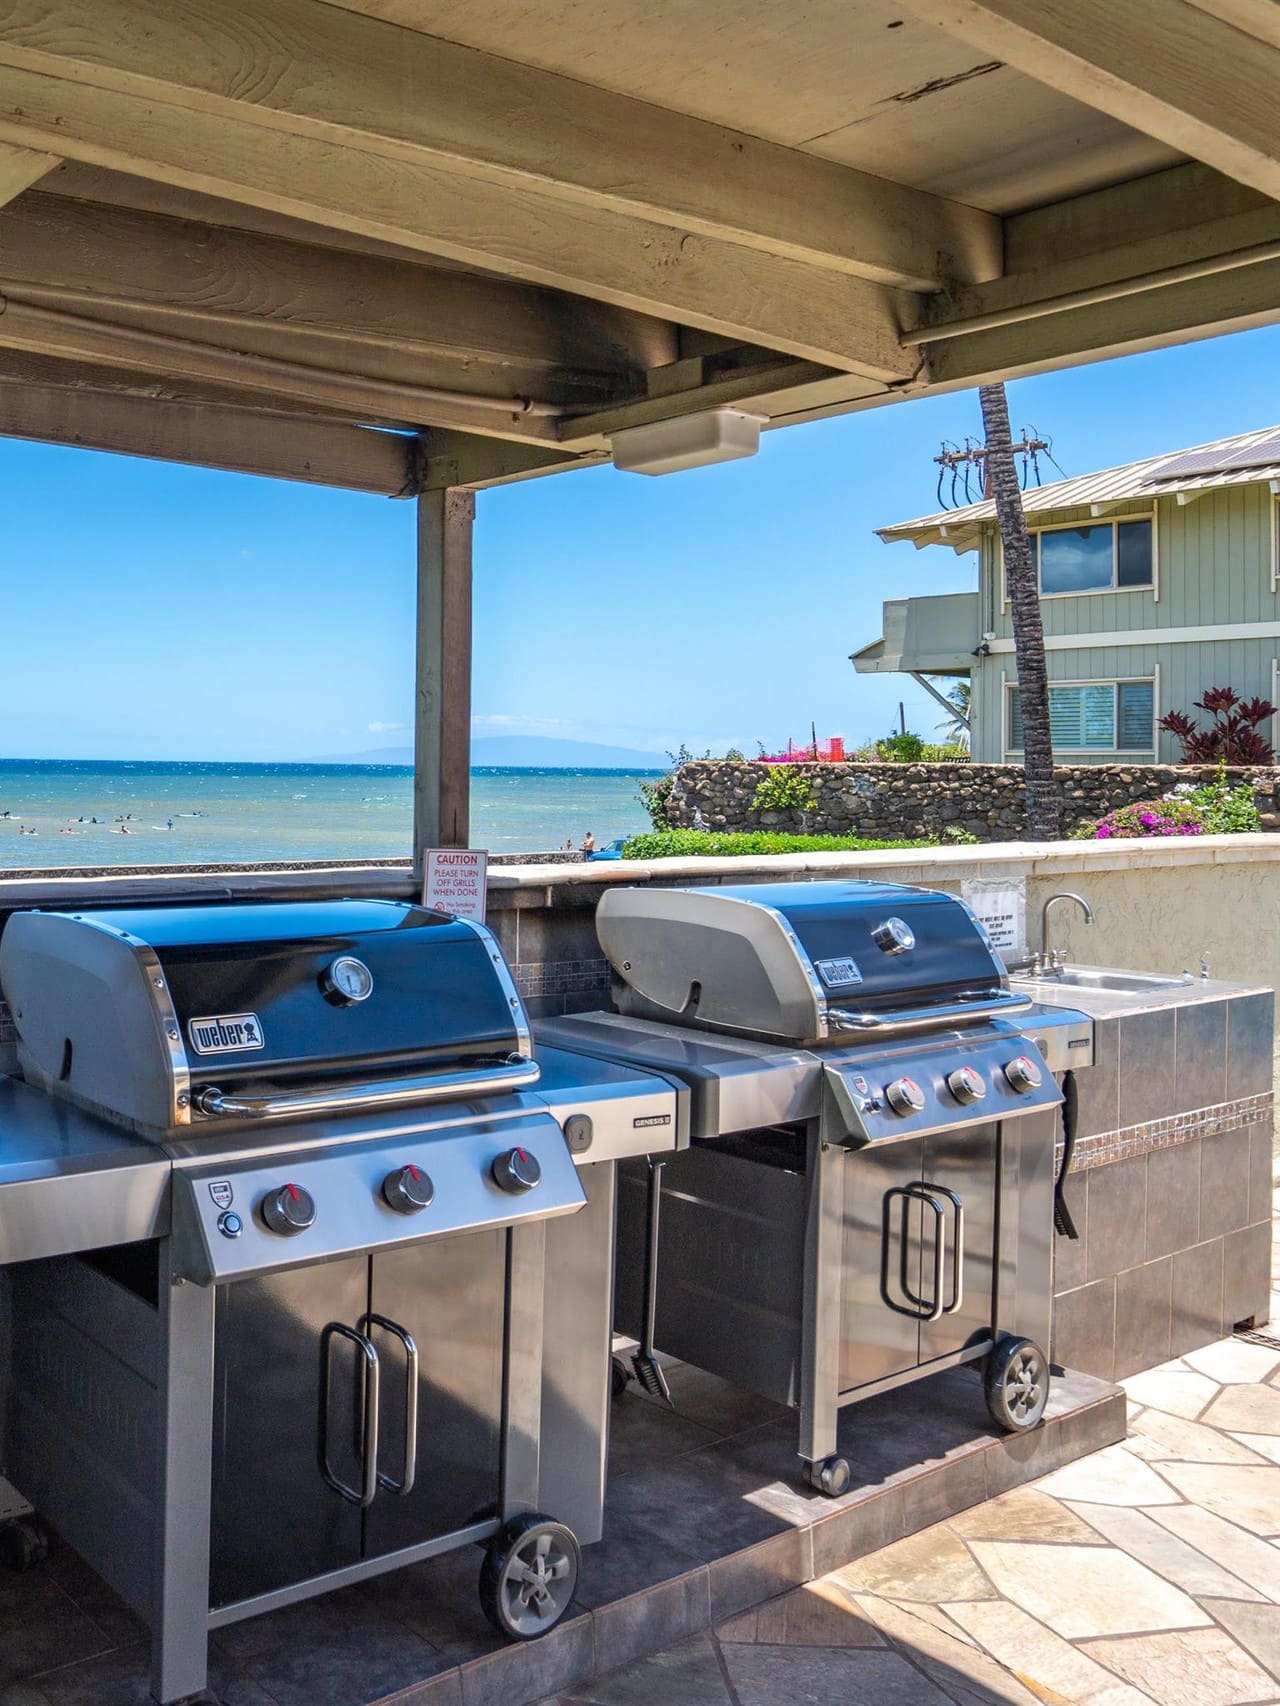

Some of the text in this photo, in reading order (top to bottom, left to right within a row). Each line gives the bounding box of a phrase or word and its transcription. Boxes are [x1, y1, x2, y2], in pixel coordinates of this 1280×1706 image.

[437, 855, 478, 864] CAUTION
[437, 879, 475, 887] OFF GRILLS
[824, 961, 850, 981] weber
[197, 1020, 243, 1048] weber
[635, 1117, 665, 1126] GENESIS
